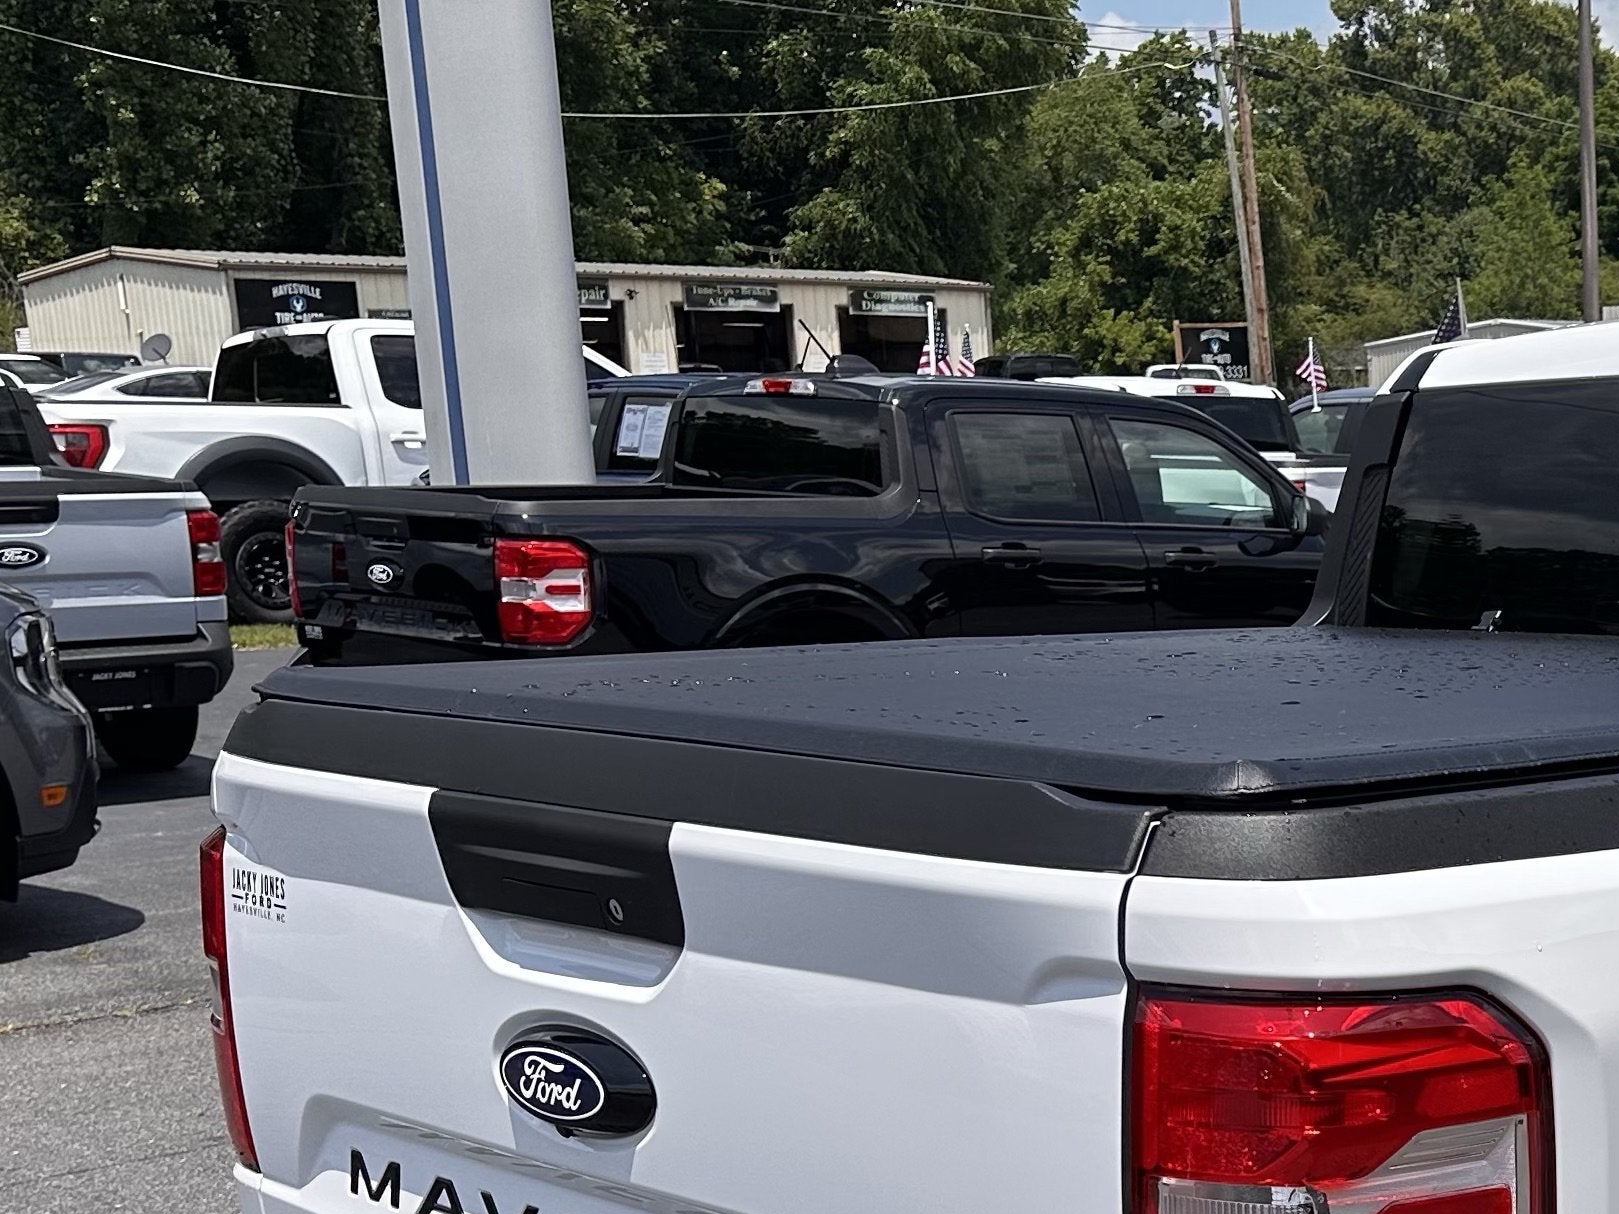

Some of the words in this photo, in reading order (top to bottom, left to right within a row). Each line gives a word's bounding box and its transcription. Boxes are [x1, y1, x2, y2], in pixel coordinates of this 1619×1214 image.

[272, 283, 322, 299] HAYESVILLE
[863, 290, 920, 302] Computer
[728, 297, 759, 308] Repair
[862, 300, 926, 312] Diagnostics
[2, 549, 30, 562] Ford
[232, 867, 258, 894] JACKY
[260, 872, 285, 900] JONES
[245, 892, 272, 909] FORD
[520, 1055, 582, 1111] Ford
